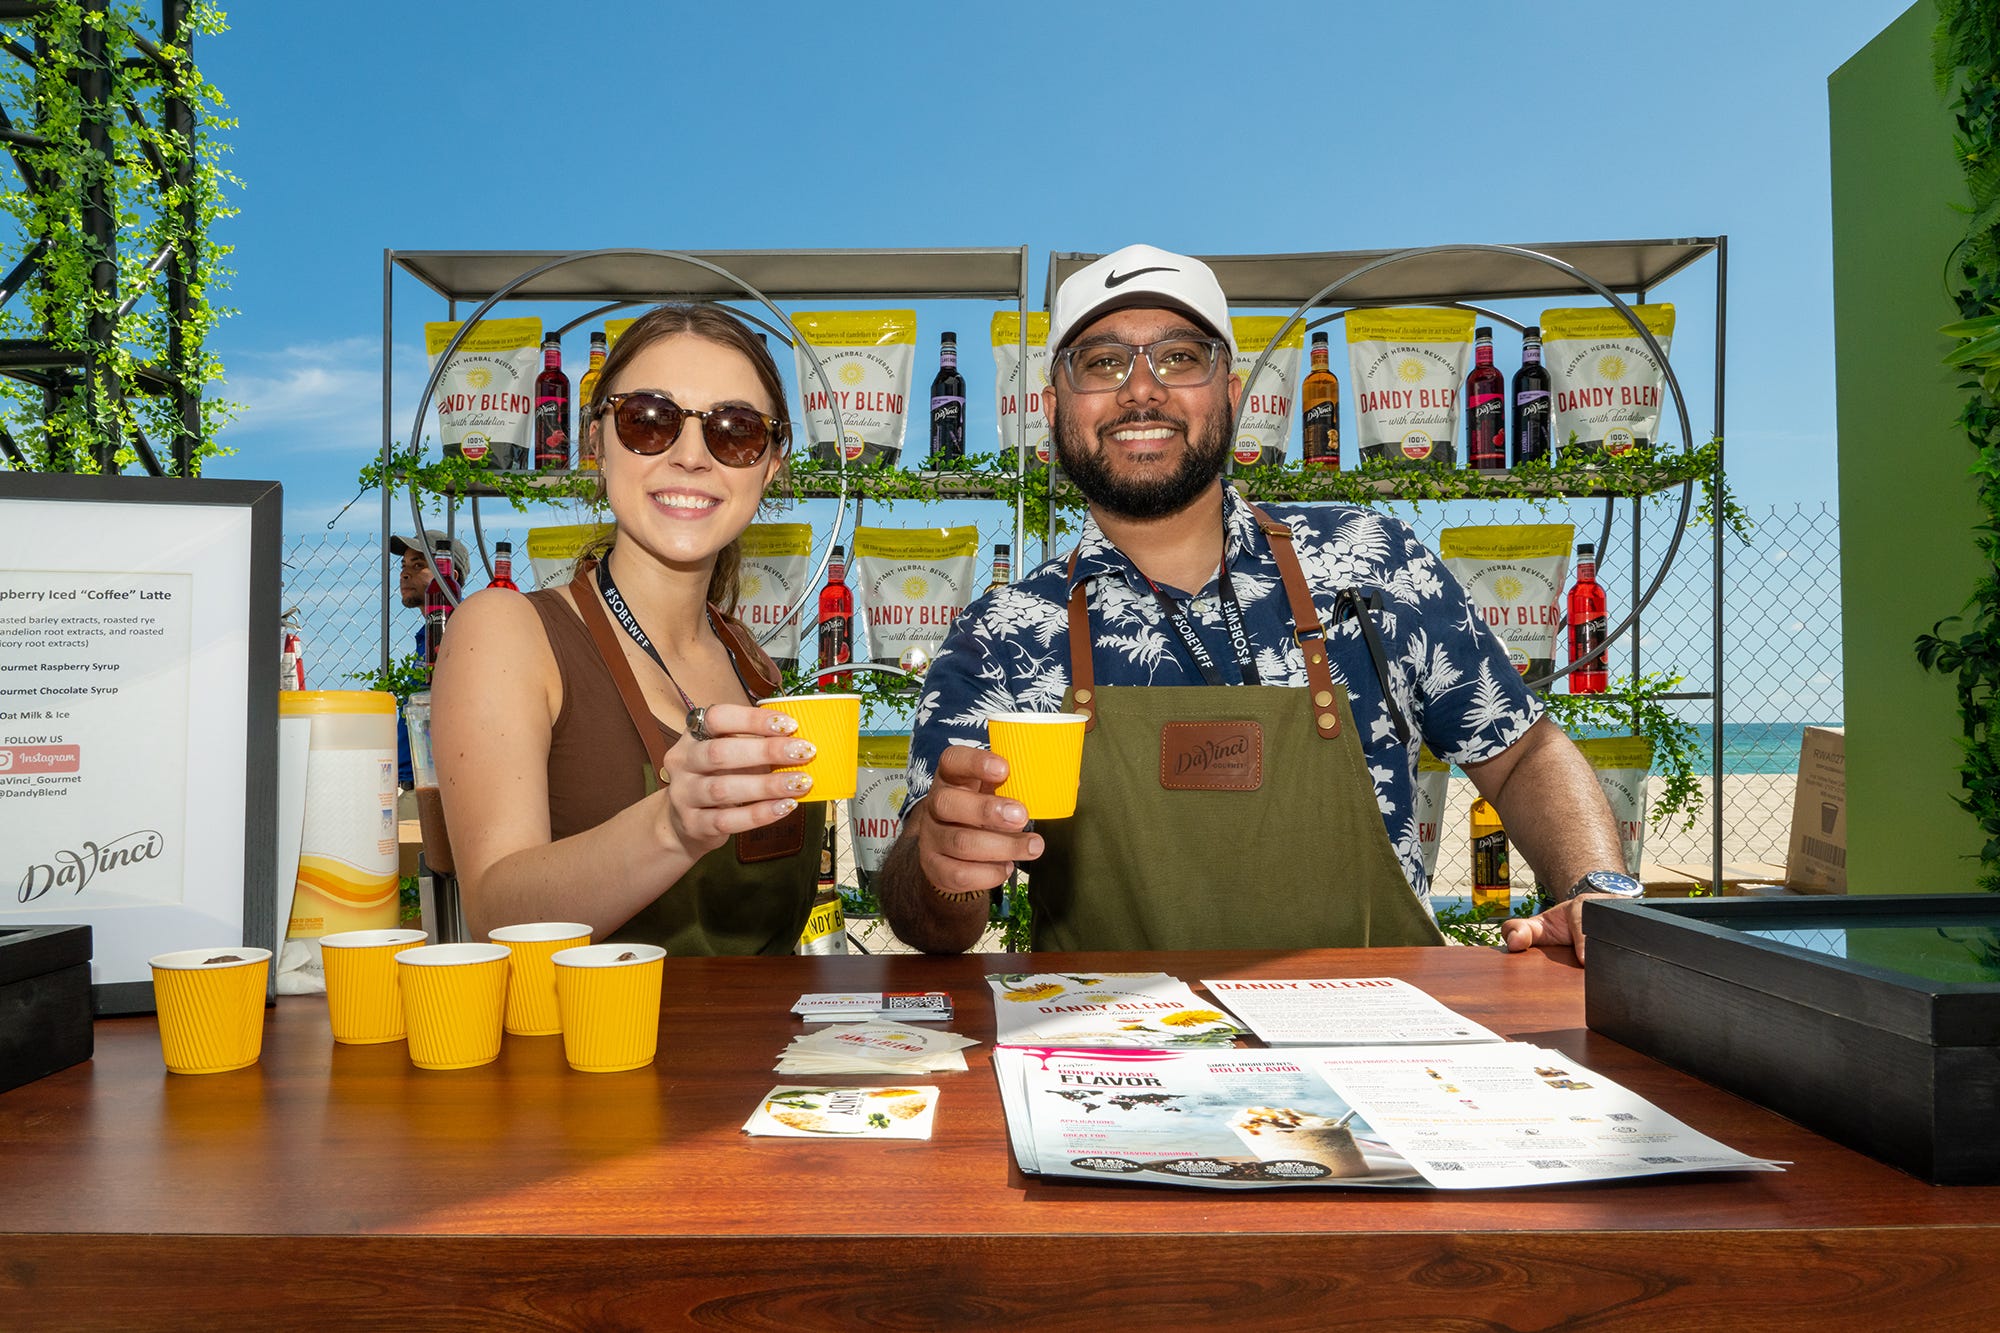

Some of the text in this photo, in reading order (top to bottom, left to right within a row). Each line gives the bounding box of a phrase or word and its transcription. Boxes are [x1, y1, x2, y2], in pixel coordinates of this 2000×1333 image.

[834, 351, 895, 379] HERBAL BEVERAGE
[1367, 346, 1457, 379] INSTANT HERBAL BEVERAGE
[1566, 343, 1659, 377] INSTANT HERBAL BEVERAGE
[494, 359, 519, 380] BEVERAGE
[481, 393, 531, 415] BLEND
[855, 391, 903, 415] BLEND
[1360, 390, 1417, 413] DANDY
[1558, 385, 1660, 413] DANDY BLEN
[450, 413, 506, 427] with dandelion
[842, 412, 881, 428] dandelion
[1388, 410, 1450, 426] with dandelion
[1589, 413, 1609, 424] with
[843, 436, 859, 444] 00%
[1238, 440, 1256, 448] 100%
[1408, 436, 1427, 444] 100%
[1610, 433, 1629, 441] 100%
[763, 564, 791, 592] BEVERAGE
[873, 564, 958, 594] INSTANT HERBAL BEVERAGE
[1487, 564, 1517, 573] HERBAL
[1520, 565, 1554, 592] BEVERAGE
[49, 589, 76, 600] Iced
[81, 589, 136, 600] “Coffee”
[140, 590, 172, 600] Latte
[0, 616, 26, 624] asted
[29, 616, 59, 625] barley
[61, 616, 101, 625] extracts,
[103, 616, 138, 624] roasted
[604, 586, 650, 649] #SOBEWFF
[868, 605, 914, 627] DANDY
[0, 628, 41, 636] andelion
[44, 628, 64, 636] root
[109, 628, 127, 636] and
[129, 628, 164, 636] roasted
[888, 631, 906, 641] with
[1223, 600, 1252, 666] #SOBEWFF
[1503, 627, 1546, 642] dandelion
[25, 640, 46, 648] root
[48, 639, 89, 648] extracts)
[1171, 613, 1214, 669] #SOBEWFF
[0, 663, 120, 673] ourmet Raspberry Syrup
[40, 686, 88, 695] Chocolate
[91, 686, 119, 695] Syrup
[0, 711, 70, 720] Oat Milk & Ice
[4, 735, 63, 744] FOLLOW US
[19, 752, 76, 767] Instagram
[1175, 734, 1249, 776] DaVinci
[858, 773, 907, 806] INSTANT HERB
[17, 829, 164, 904] DaVinci
[808, 912, 831, 936] NDY
[1309, 981, 1393, 989] BLEND
[1038, 1001, 1185, 1014] DANDY BLEND
[1248, 1065, 1302, 1073] FLAVOR
[1060, 1074, 1162, 1087] FLAVOR
